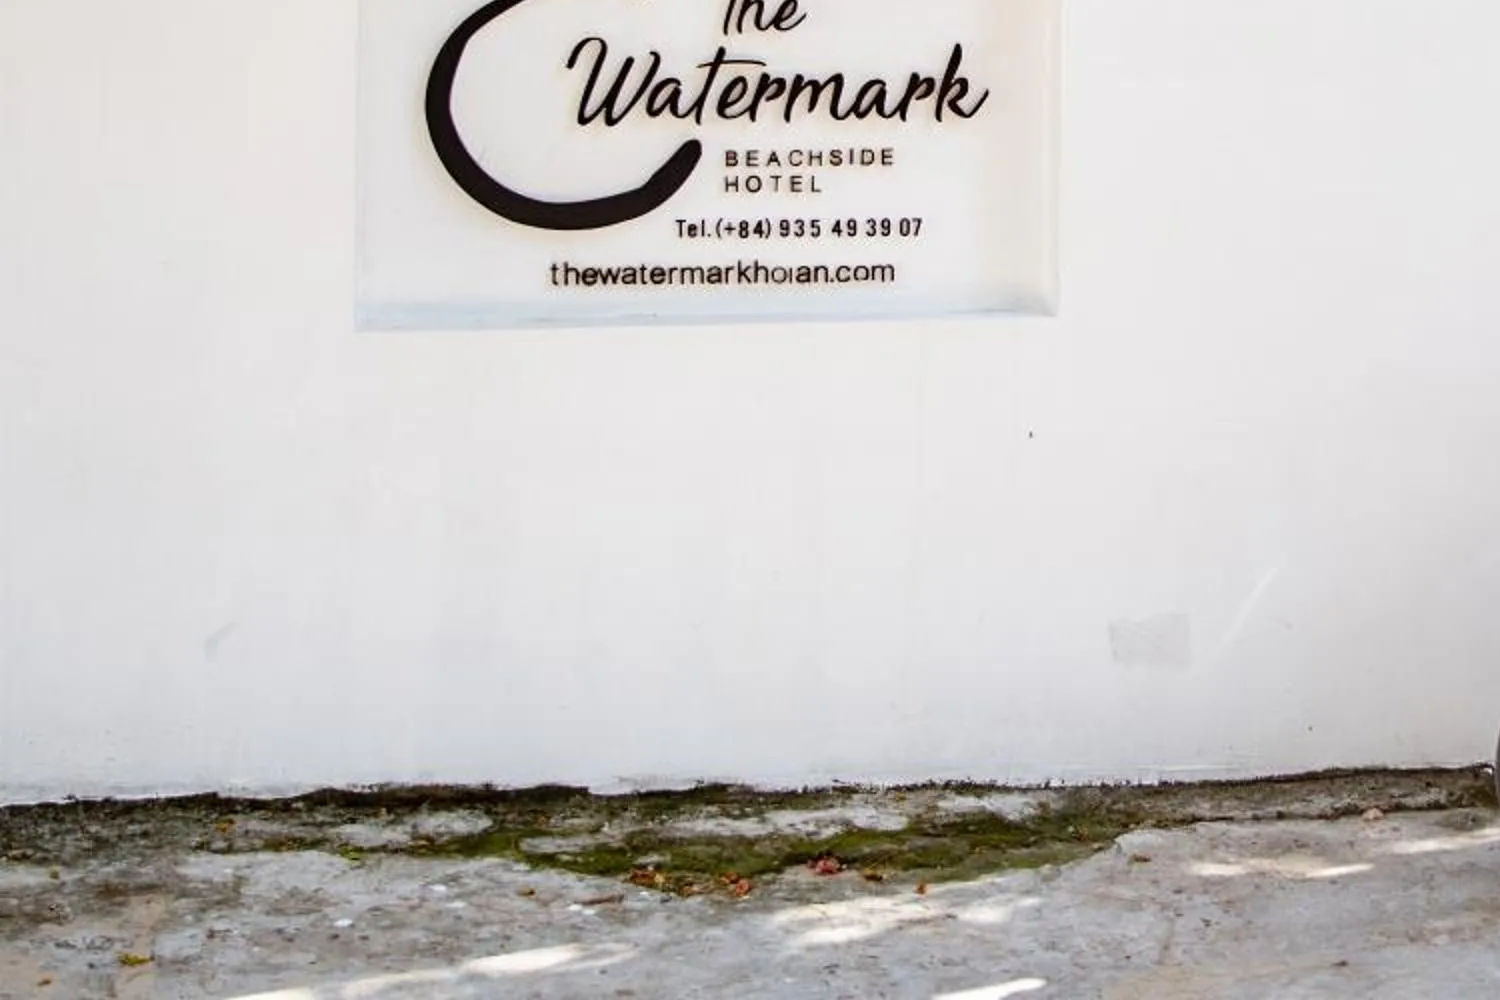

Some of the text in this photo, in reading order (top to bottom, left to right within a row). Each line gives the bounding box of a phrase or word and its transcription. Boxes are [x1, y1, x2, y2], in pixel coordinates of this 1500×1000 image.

[565, 36, 990, 128] Watermark
[725, 148, 894, 168] BEACHSIDE
[724, 174, 822, 194] HOTEL
[778, 218, 822, 239] 935
[831, 218, 859, 238] 49
[865, 217, 893, 238] 39
[899, 216, 924, 238] 07
